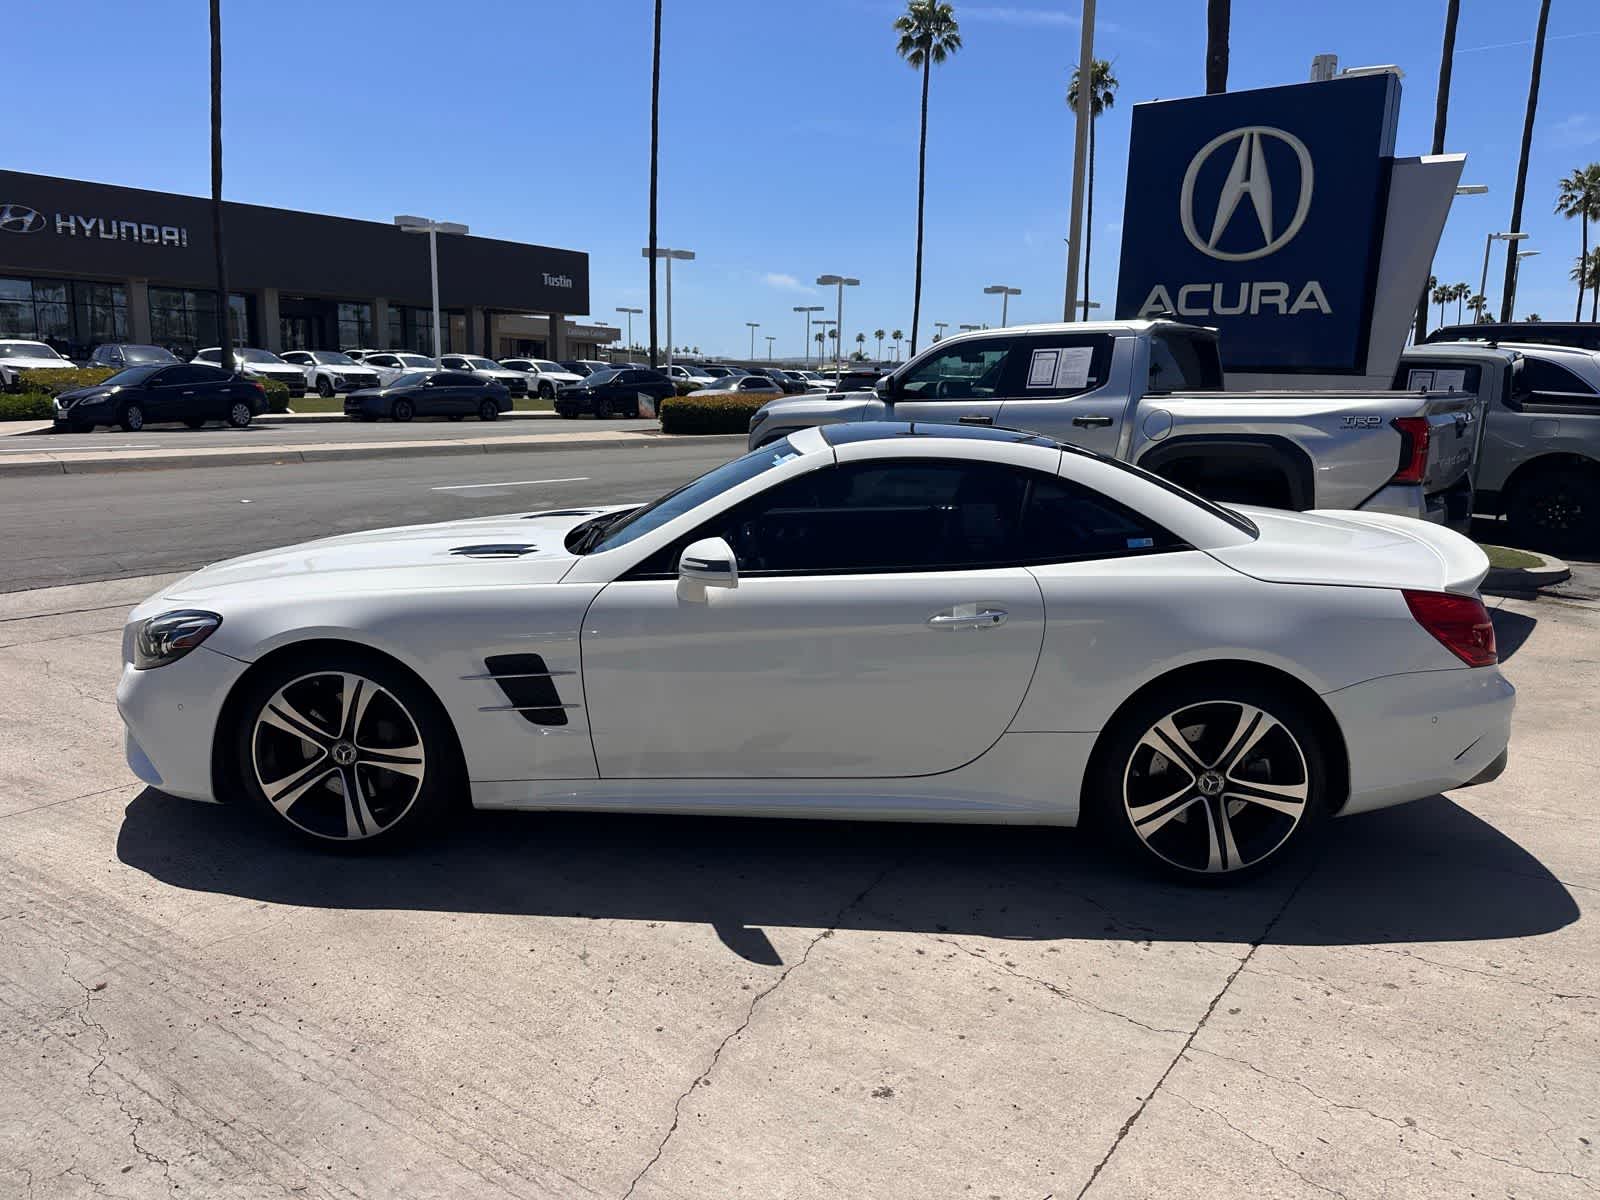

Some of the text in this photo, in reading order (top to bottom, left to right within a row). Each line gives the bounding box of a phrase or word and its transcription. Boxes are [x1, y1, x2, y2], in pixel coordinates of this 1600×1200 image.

[56, 213, 187, 247] HYUNDAI
[541, 272, 572, 288] Tustin
[1137, 281, 1332, 317] ACURA
[1342, 415, 1382, 425] TRD
